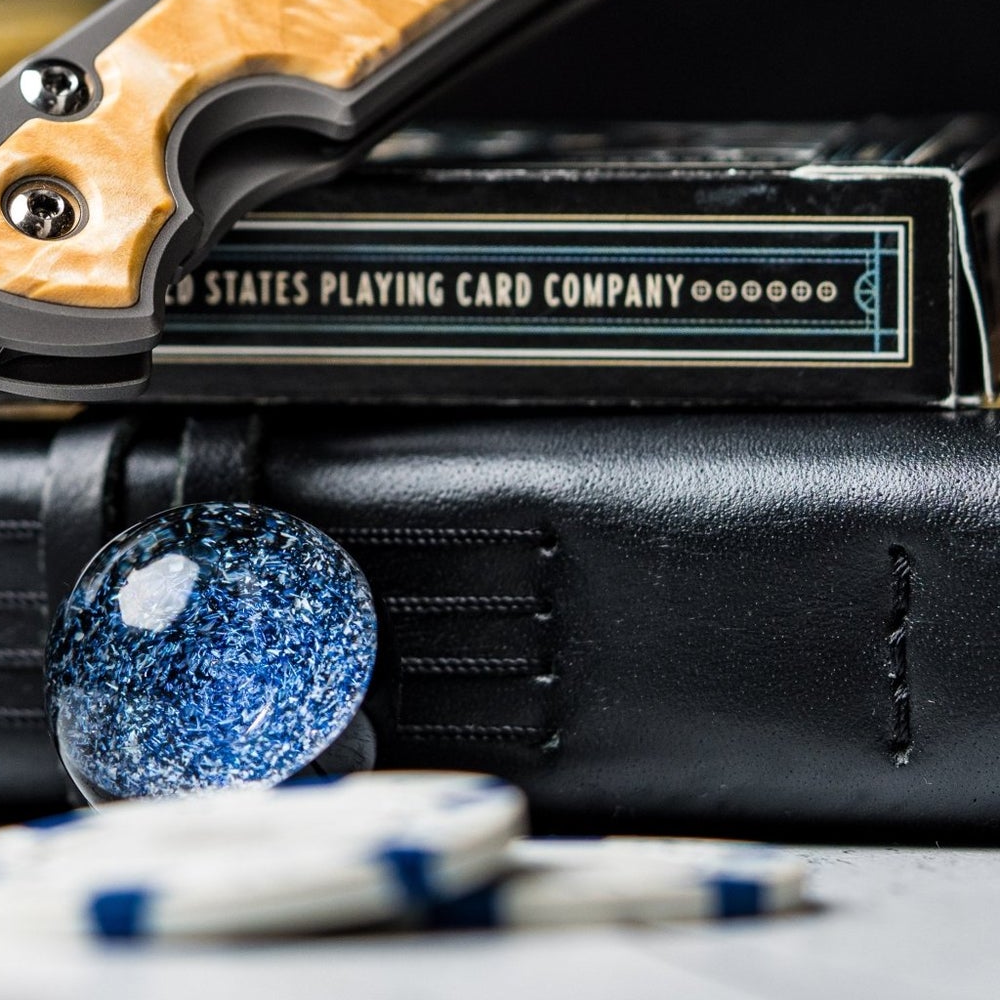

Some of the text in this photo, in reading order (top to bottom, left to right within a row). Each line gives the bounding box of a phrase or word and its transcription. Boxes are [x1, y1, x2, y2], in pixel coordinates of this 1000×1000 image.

[204, 270, 309, 307] STATES
[320, 271, 445, 307] PLAYING
[456, 272, 532, 308] CARD
[544, 273, 684, 308] COMPANY
